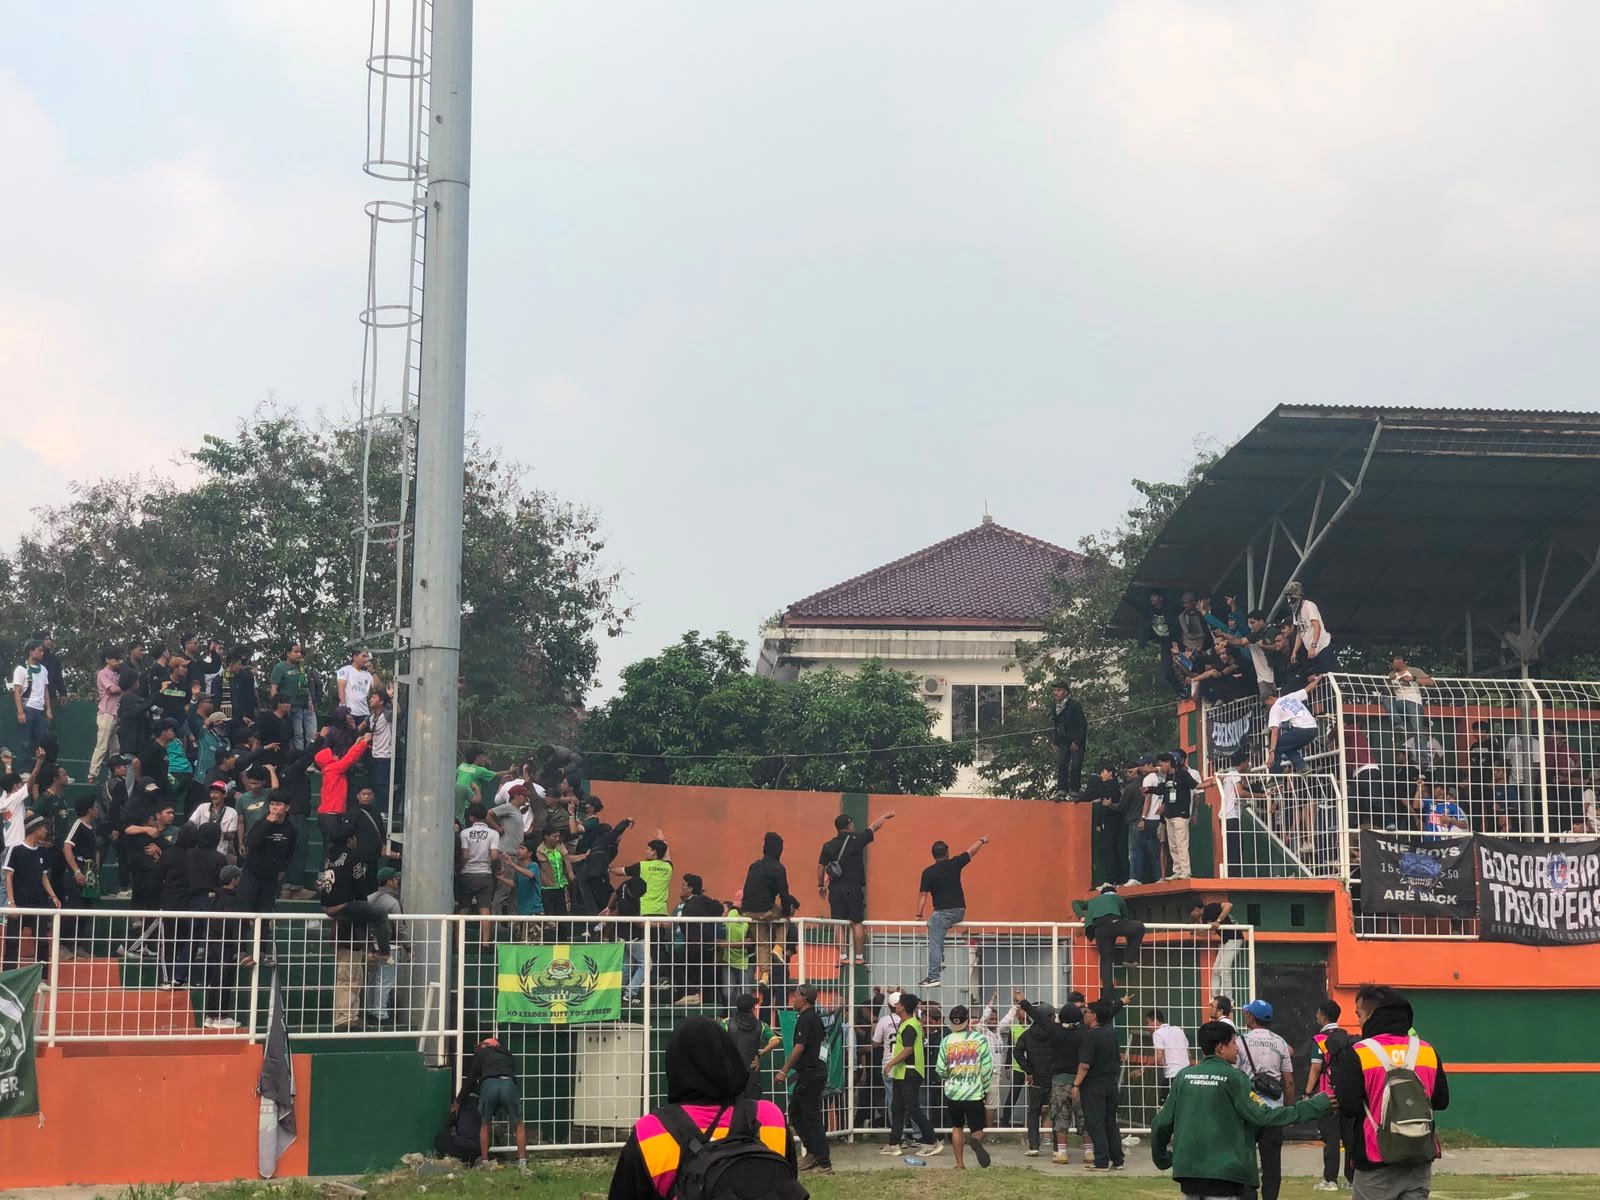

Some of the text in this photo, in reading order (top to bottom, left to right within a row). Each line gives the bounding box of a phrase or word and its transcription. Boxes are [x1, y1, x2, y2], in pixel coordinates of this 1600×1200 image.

[1376, 839, 1461, 859] THE BOYS
[1447, 869, 1459, 879] 50
[1479, 846, 1553, 889] BOGOR
[1383, 889, 1458, 905] ARE BACK
